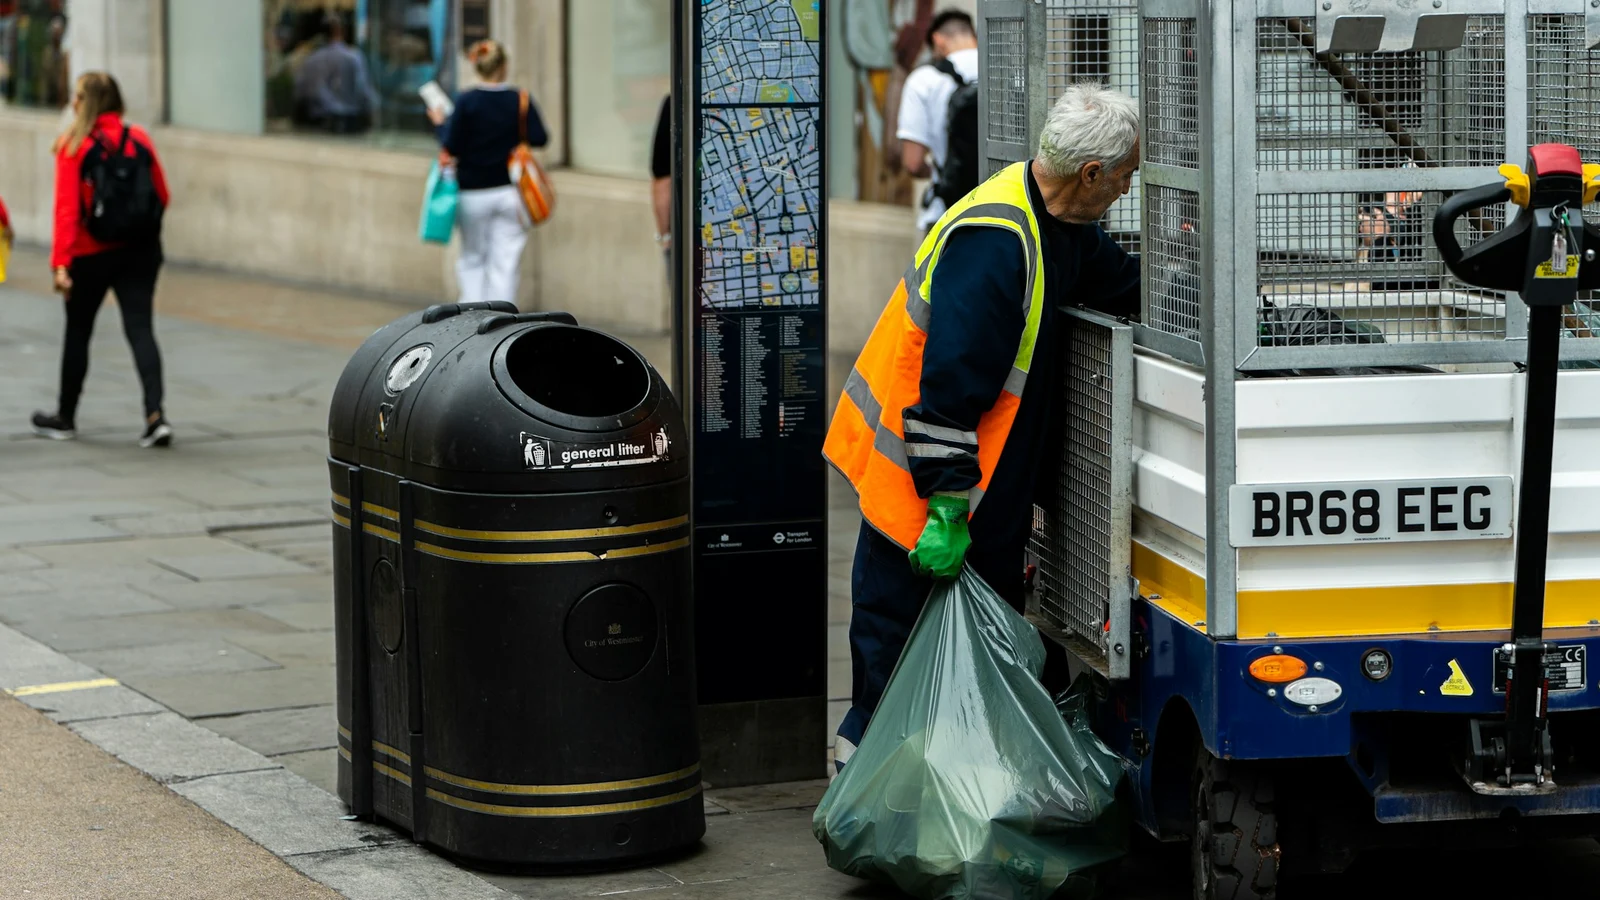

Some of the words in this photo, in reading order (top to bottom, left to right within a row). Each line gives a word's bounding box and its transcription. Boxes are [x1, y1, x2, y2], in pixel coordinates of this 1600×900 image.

[561, 443, 614, 463] general
[617, 443, 646, 456] litter
[1252, 488, 1380, 538] BR68
[1397, 485, 1492, 533] EEG
[584, 639, 598, 649] City
[598, 638, 606, 647] of
